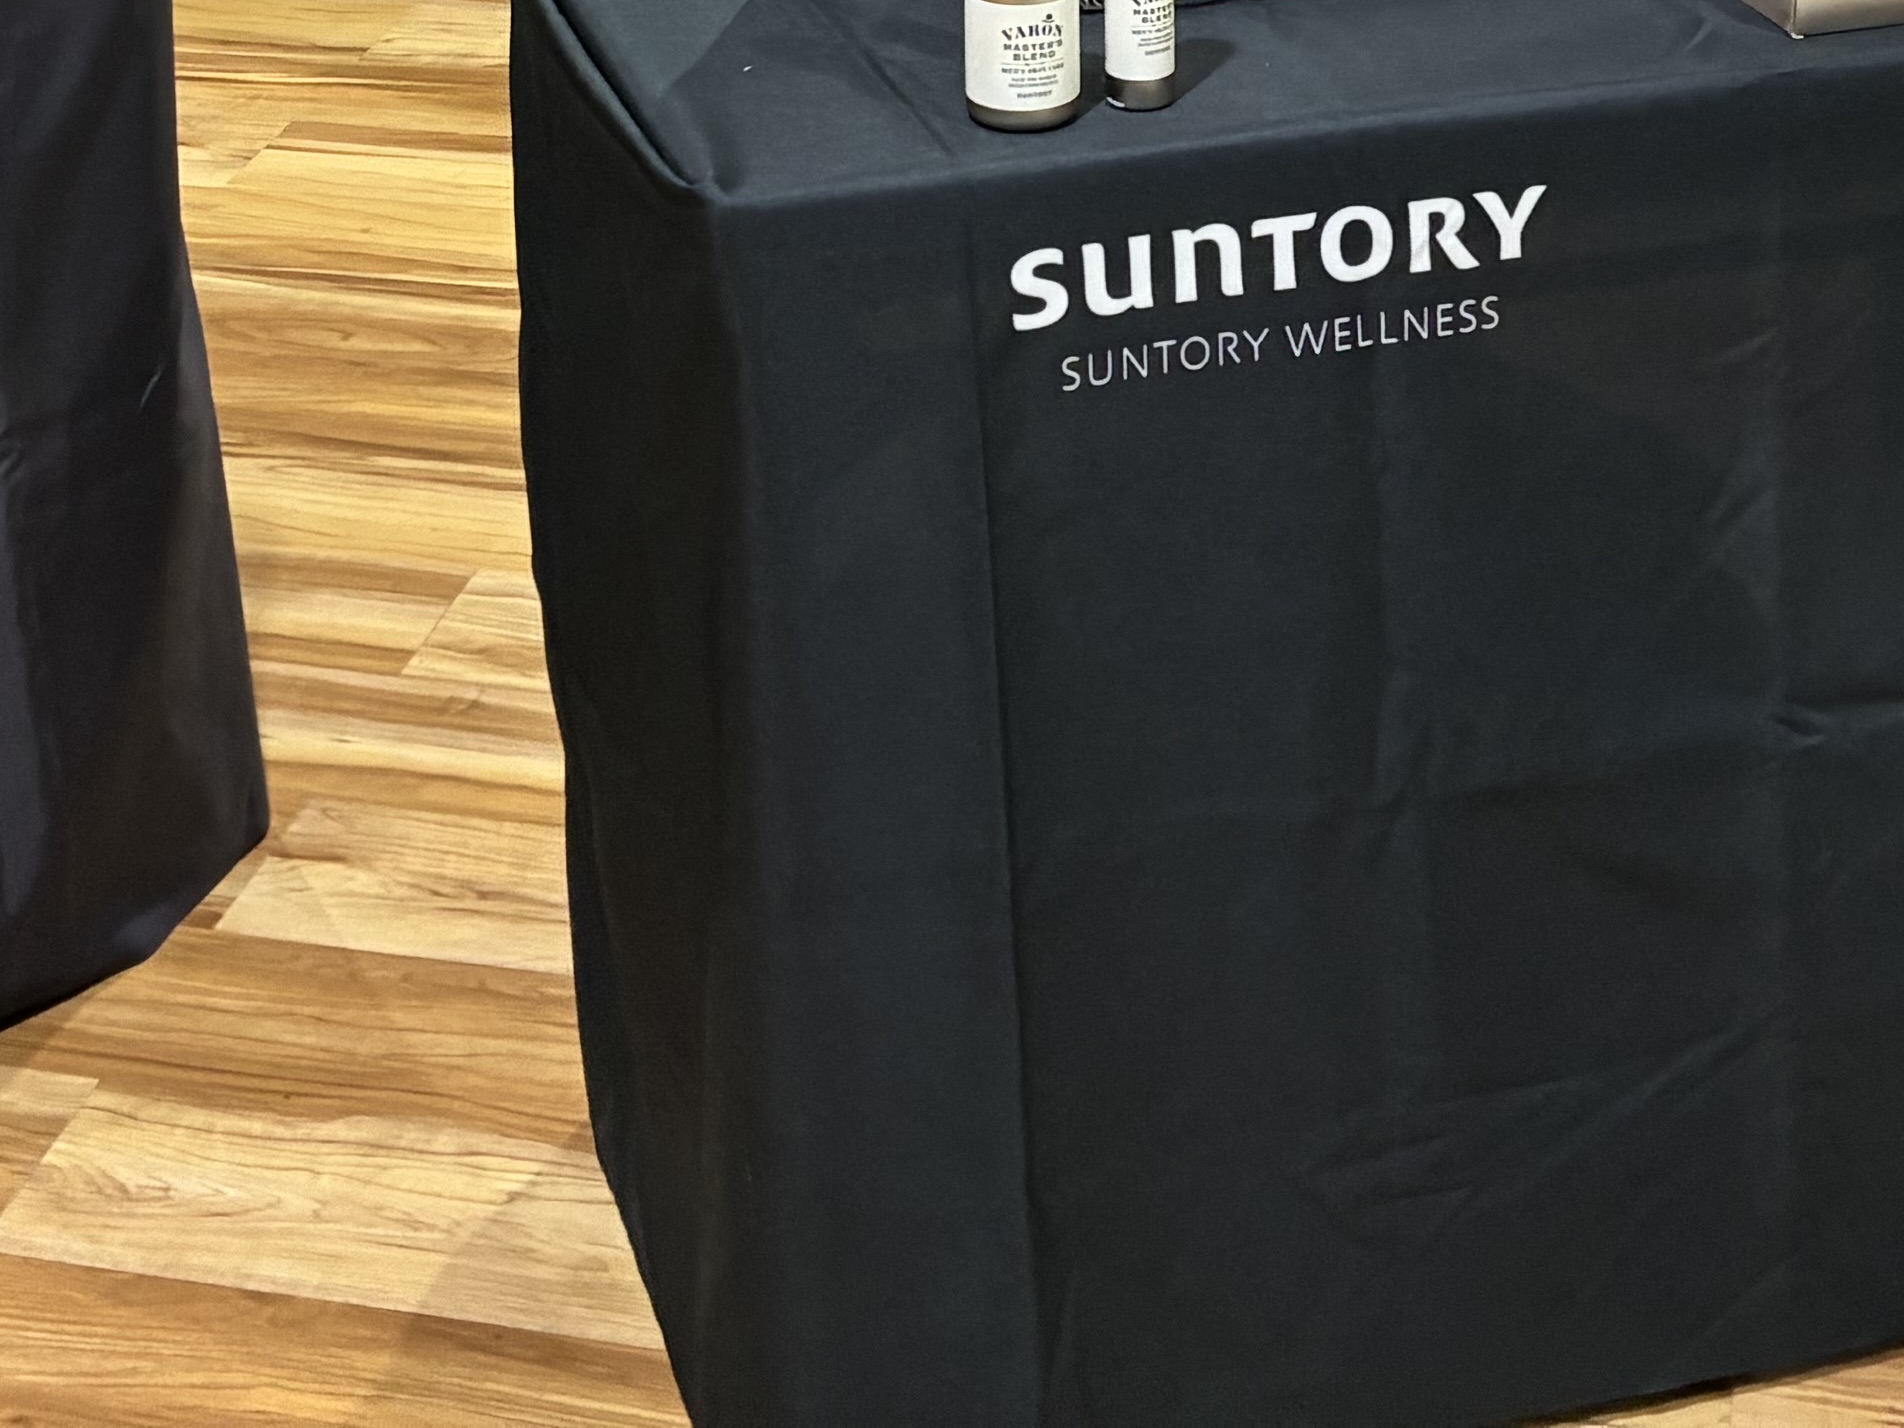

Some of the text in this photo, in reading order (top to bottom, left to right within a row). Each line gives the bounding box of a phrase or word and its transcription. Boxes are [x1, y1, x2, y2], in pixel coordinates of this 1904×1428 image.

[1007, 183, 1550, 334] SUNTORY
[1058, 294, 1502, 394] SUNTORY WELLNESS
